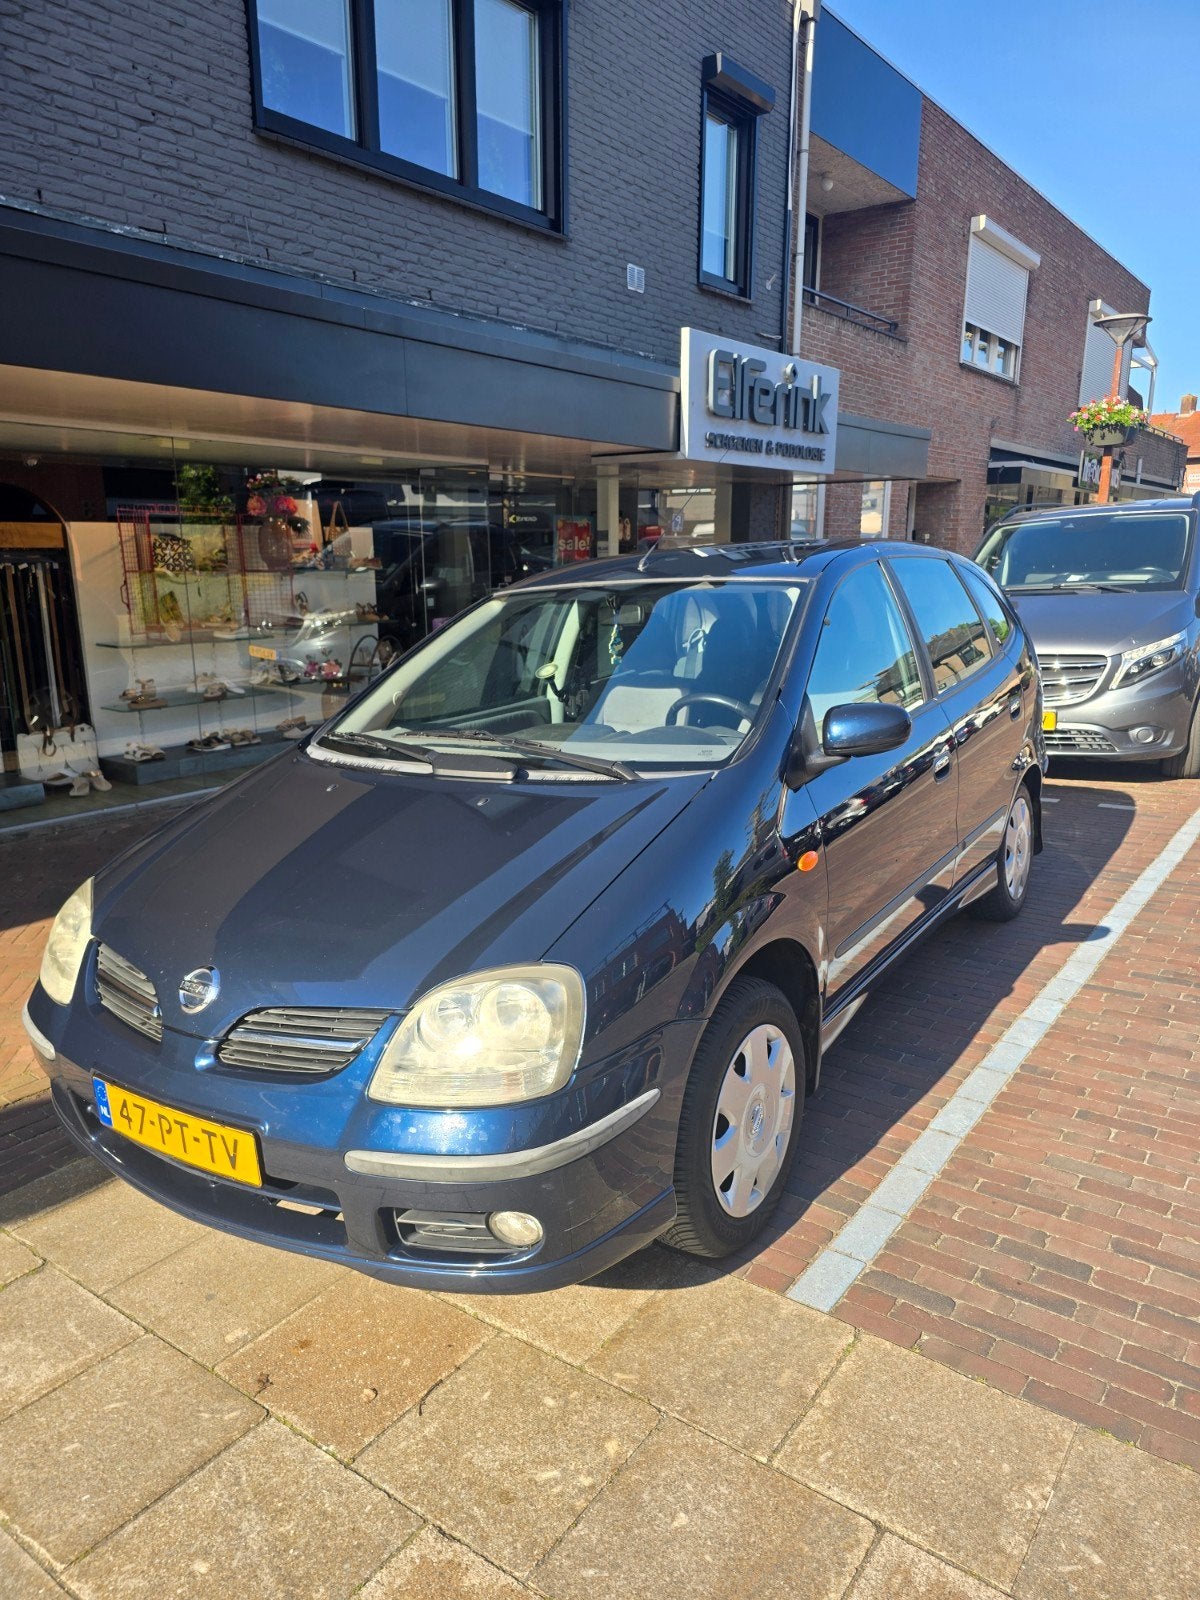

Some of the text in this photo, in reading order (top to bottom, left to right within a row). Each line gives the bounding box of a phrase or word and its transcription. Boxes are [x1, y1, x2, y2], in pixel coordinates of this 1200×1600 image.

[708, 348, 832, 435] Elferink
[704, 431, 827, 462] SCHOENEN & PODOLOGIE
[558, 535, 591, 551] sale!
[100, 1104, 111, 1119] NL
[119, 1098, 238, 1171] 47-PT-TV
